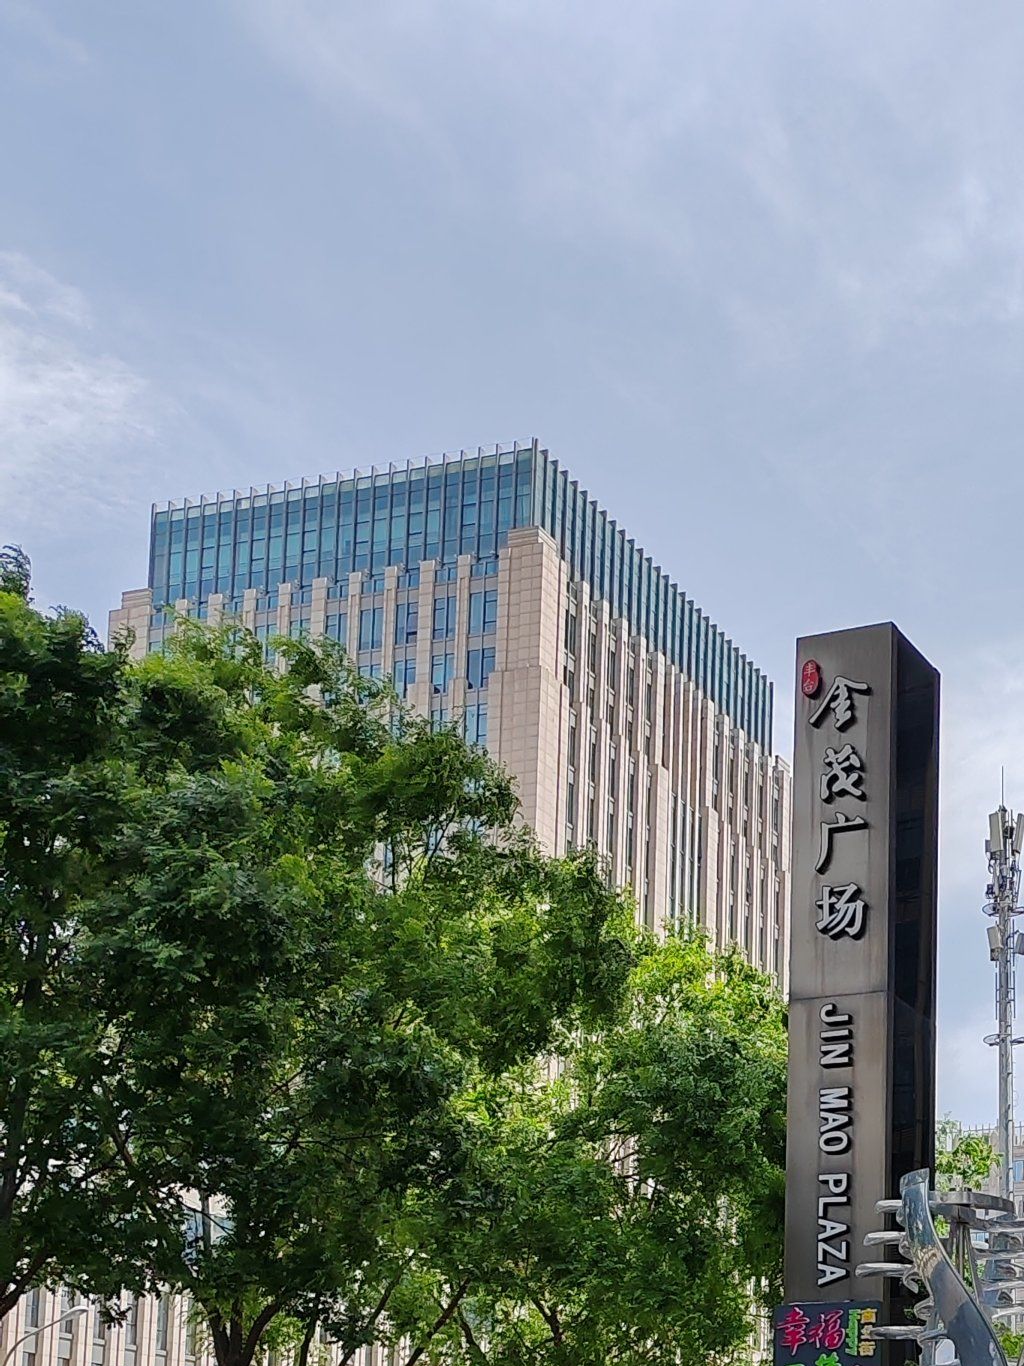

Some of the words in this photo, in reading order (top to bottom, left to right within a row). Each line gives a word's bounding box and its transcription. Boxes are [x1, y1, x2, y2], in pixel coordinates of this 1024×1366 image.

[808, 675, 869, 937] 金茂广场
[819, 1003, 850, 1068] JIN
[818, 1086, 850, 1156] MAO
[817, 1172, 848, 1286] PLAZA
[776, 1307, 844, 1356] 幸福
